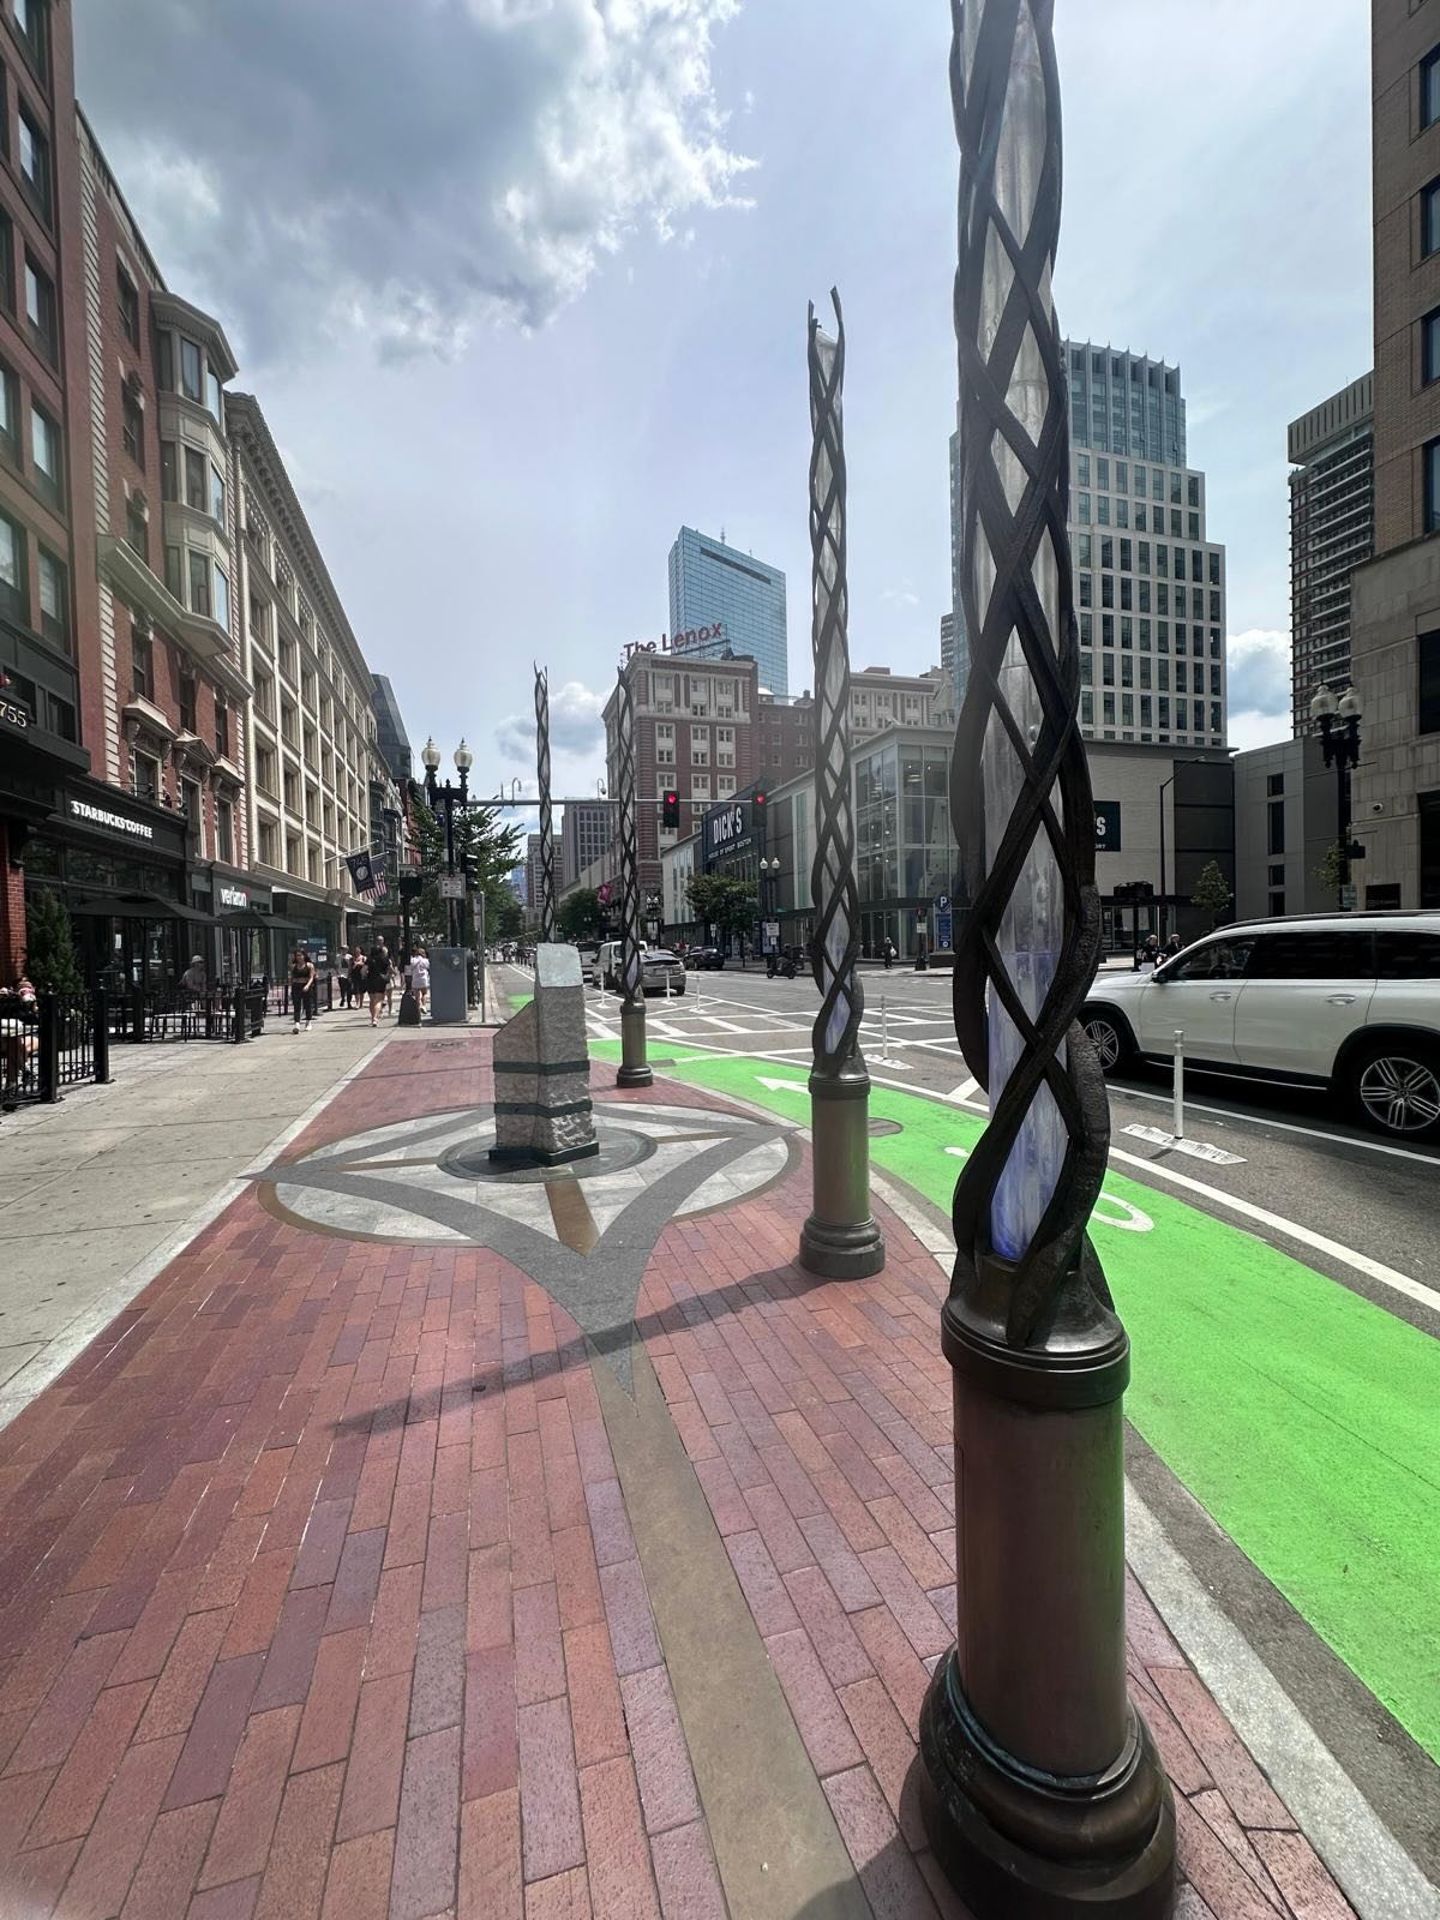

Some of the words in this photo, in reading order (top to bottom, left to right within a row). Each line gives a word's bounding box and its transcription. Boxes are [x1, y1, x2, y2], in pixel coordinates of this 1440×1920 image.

[623, 641, 657, 660] The
[662, 622, 722, 651] Lenox
[0, 701, 27, 727] 755
[70, 800, 127, 830] STARBUCKS
[125, 819, 153, 838] COFFEE
[713, 806, 743, 844] DICK'S
